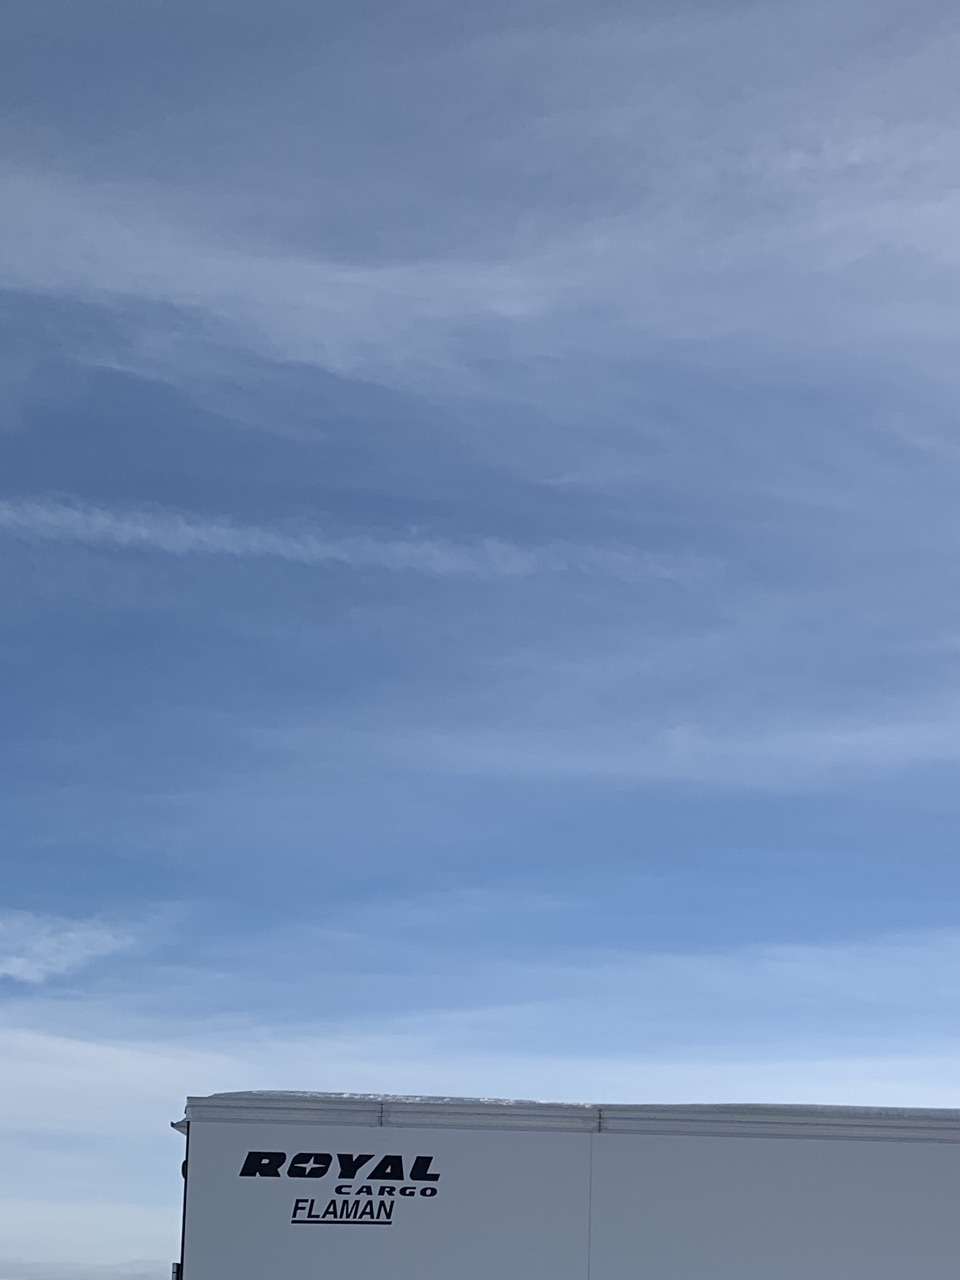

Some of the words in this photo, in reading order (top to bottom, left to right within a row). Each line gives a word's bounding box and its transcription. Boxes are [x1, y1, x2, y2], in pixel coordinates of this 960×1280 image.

[239, 1151, 441, 1182] ROYAL
[334, 1184, 438, 1198] CARGO
[291, 1199, 395, 1220] FLAMAN
